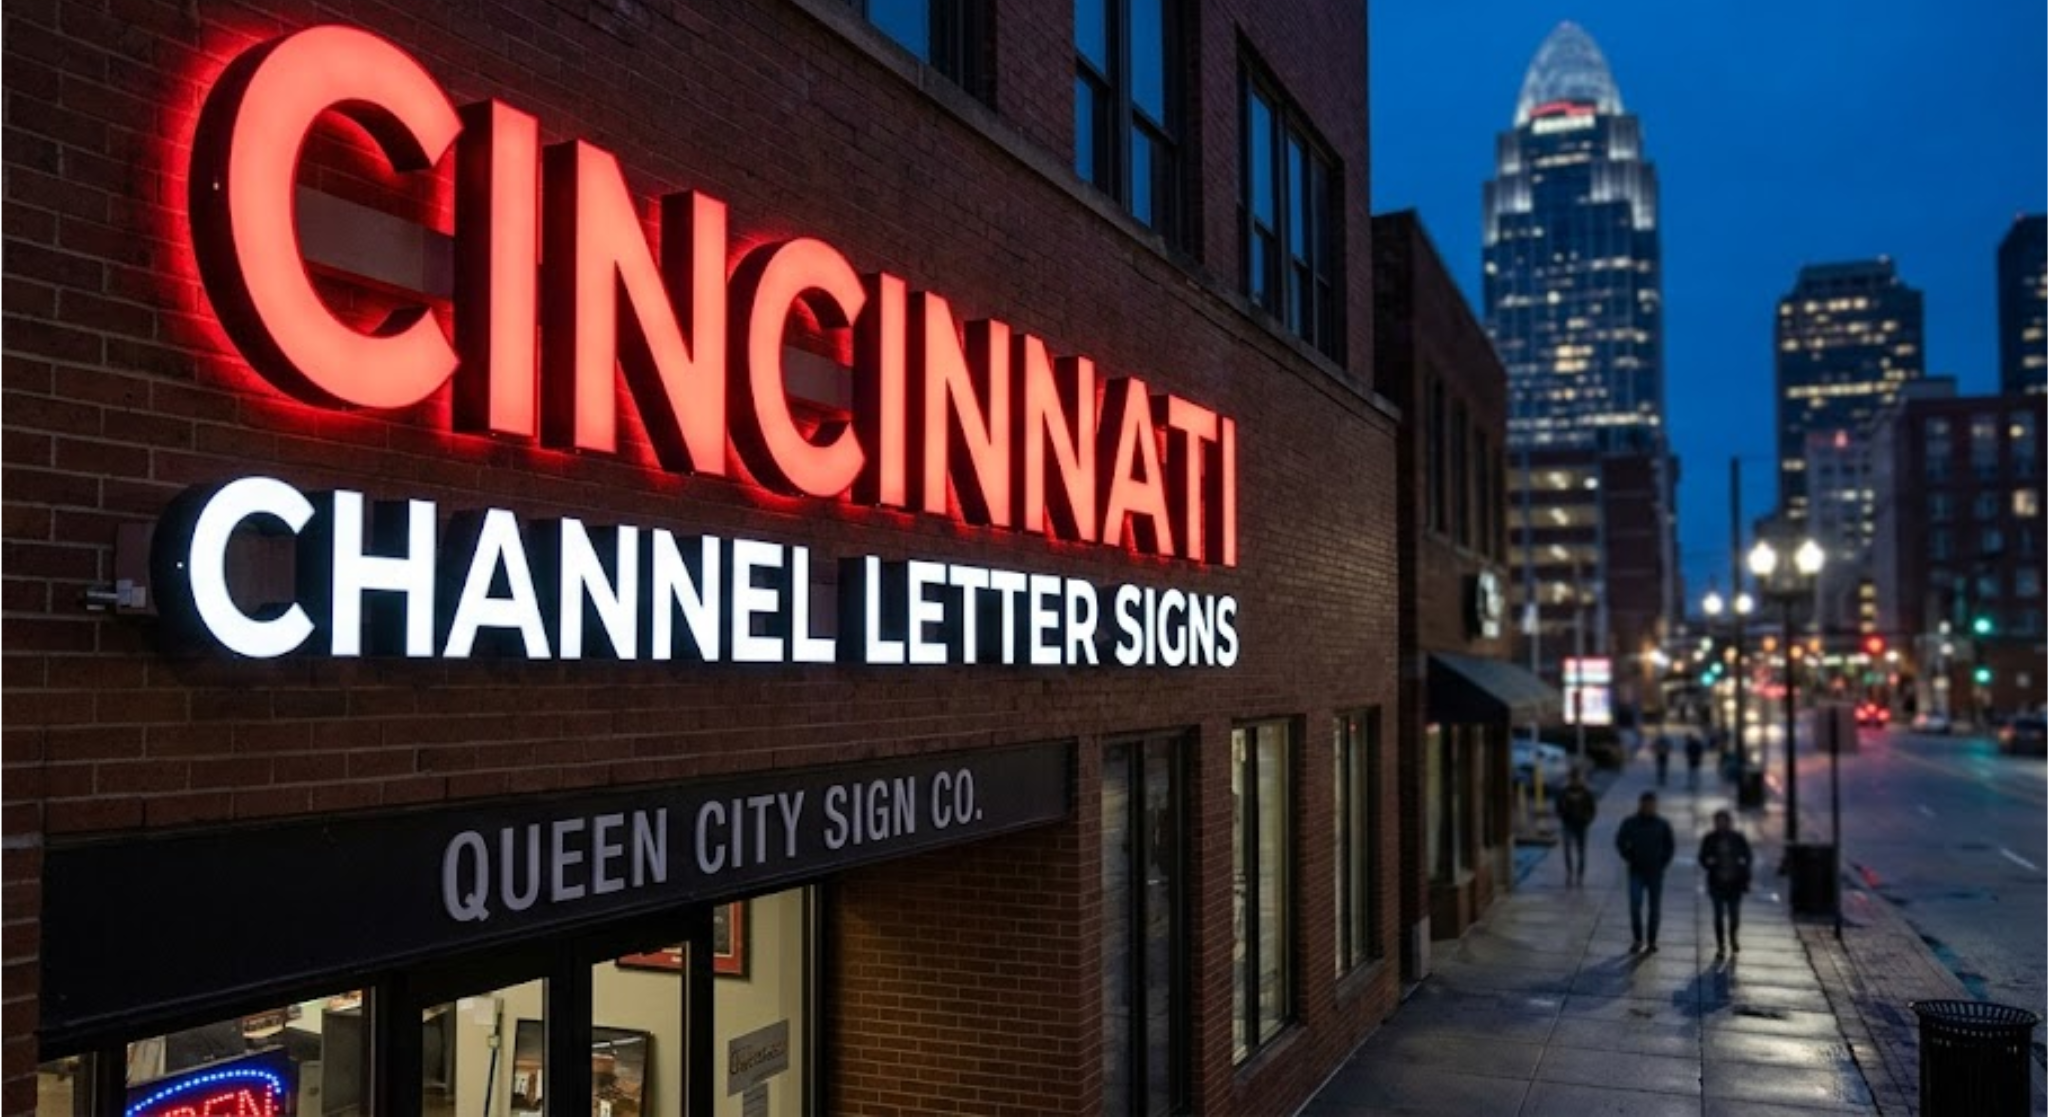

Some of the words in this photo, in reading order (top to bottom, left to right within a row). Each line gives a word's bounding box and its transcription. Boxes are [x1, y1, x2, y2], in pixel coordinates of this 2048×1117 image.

[227, 24, 1237, 567] CINCINNATI
[189, 476, 836, 660] CHANNEL
[865, 555, 1099, 665] LETTER
[1114, 583, 1239, 667] SIGNS
[442, 808, 668, 921] QUEEN
[694, 792, 804, 875] CITY
[824, 777, 915, 849] SIGN
[932, 768, 983, 829] CO.
